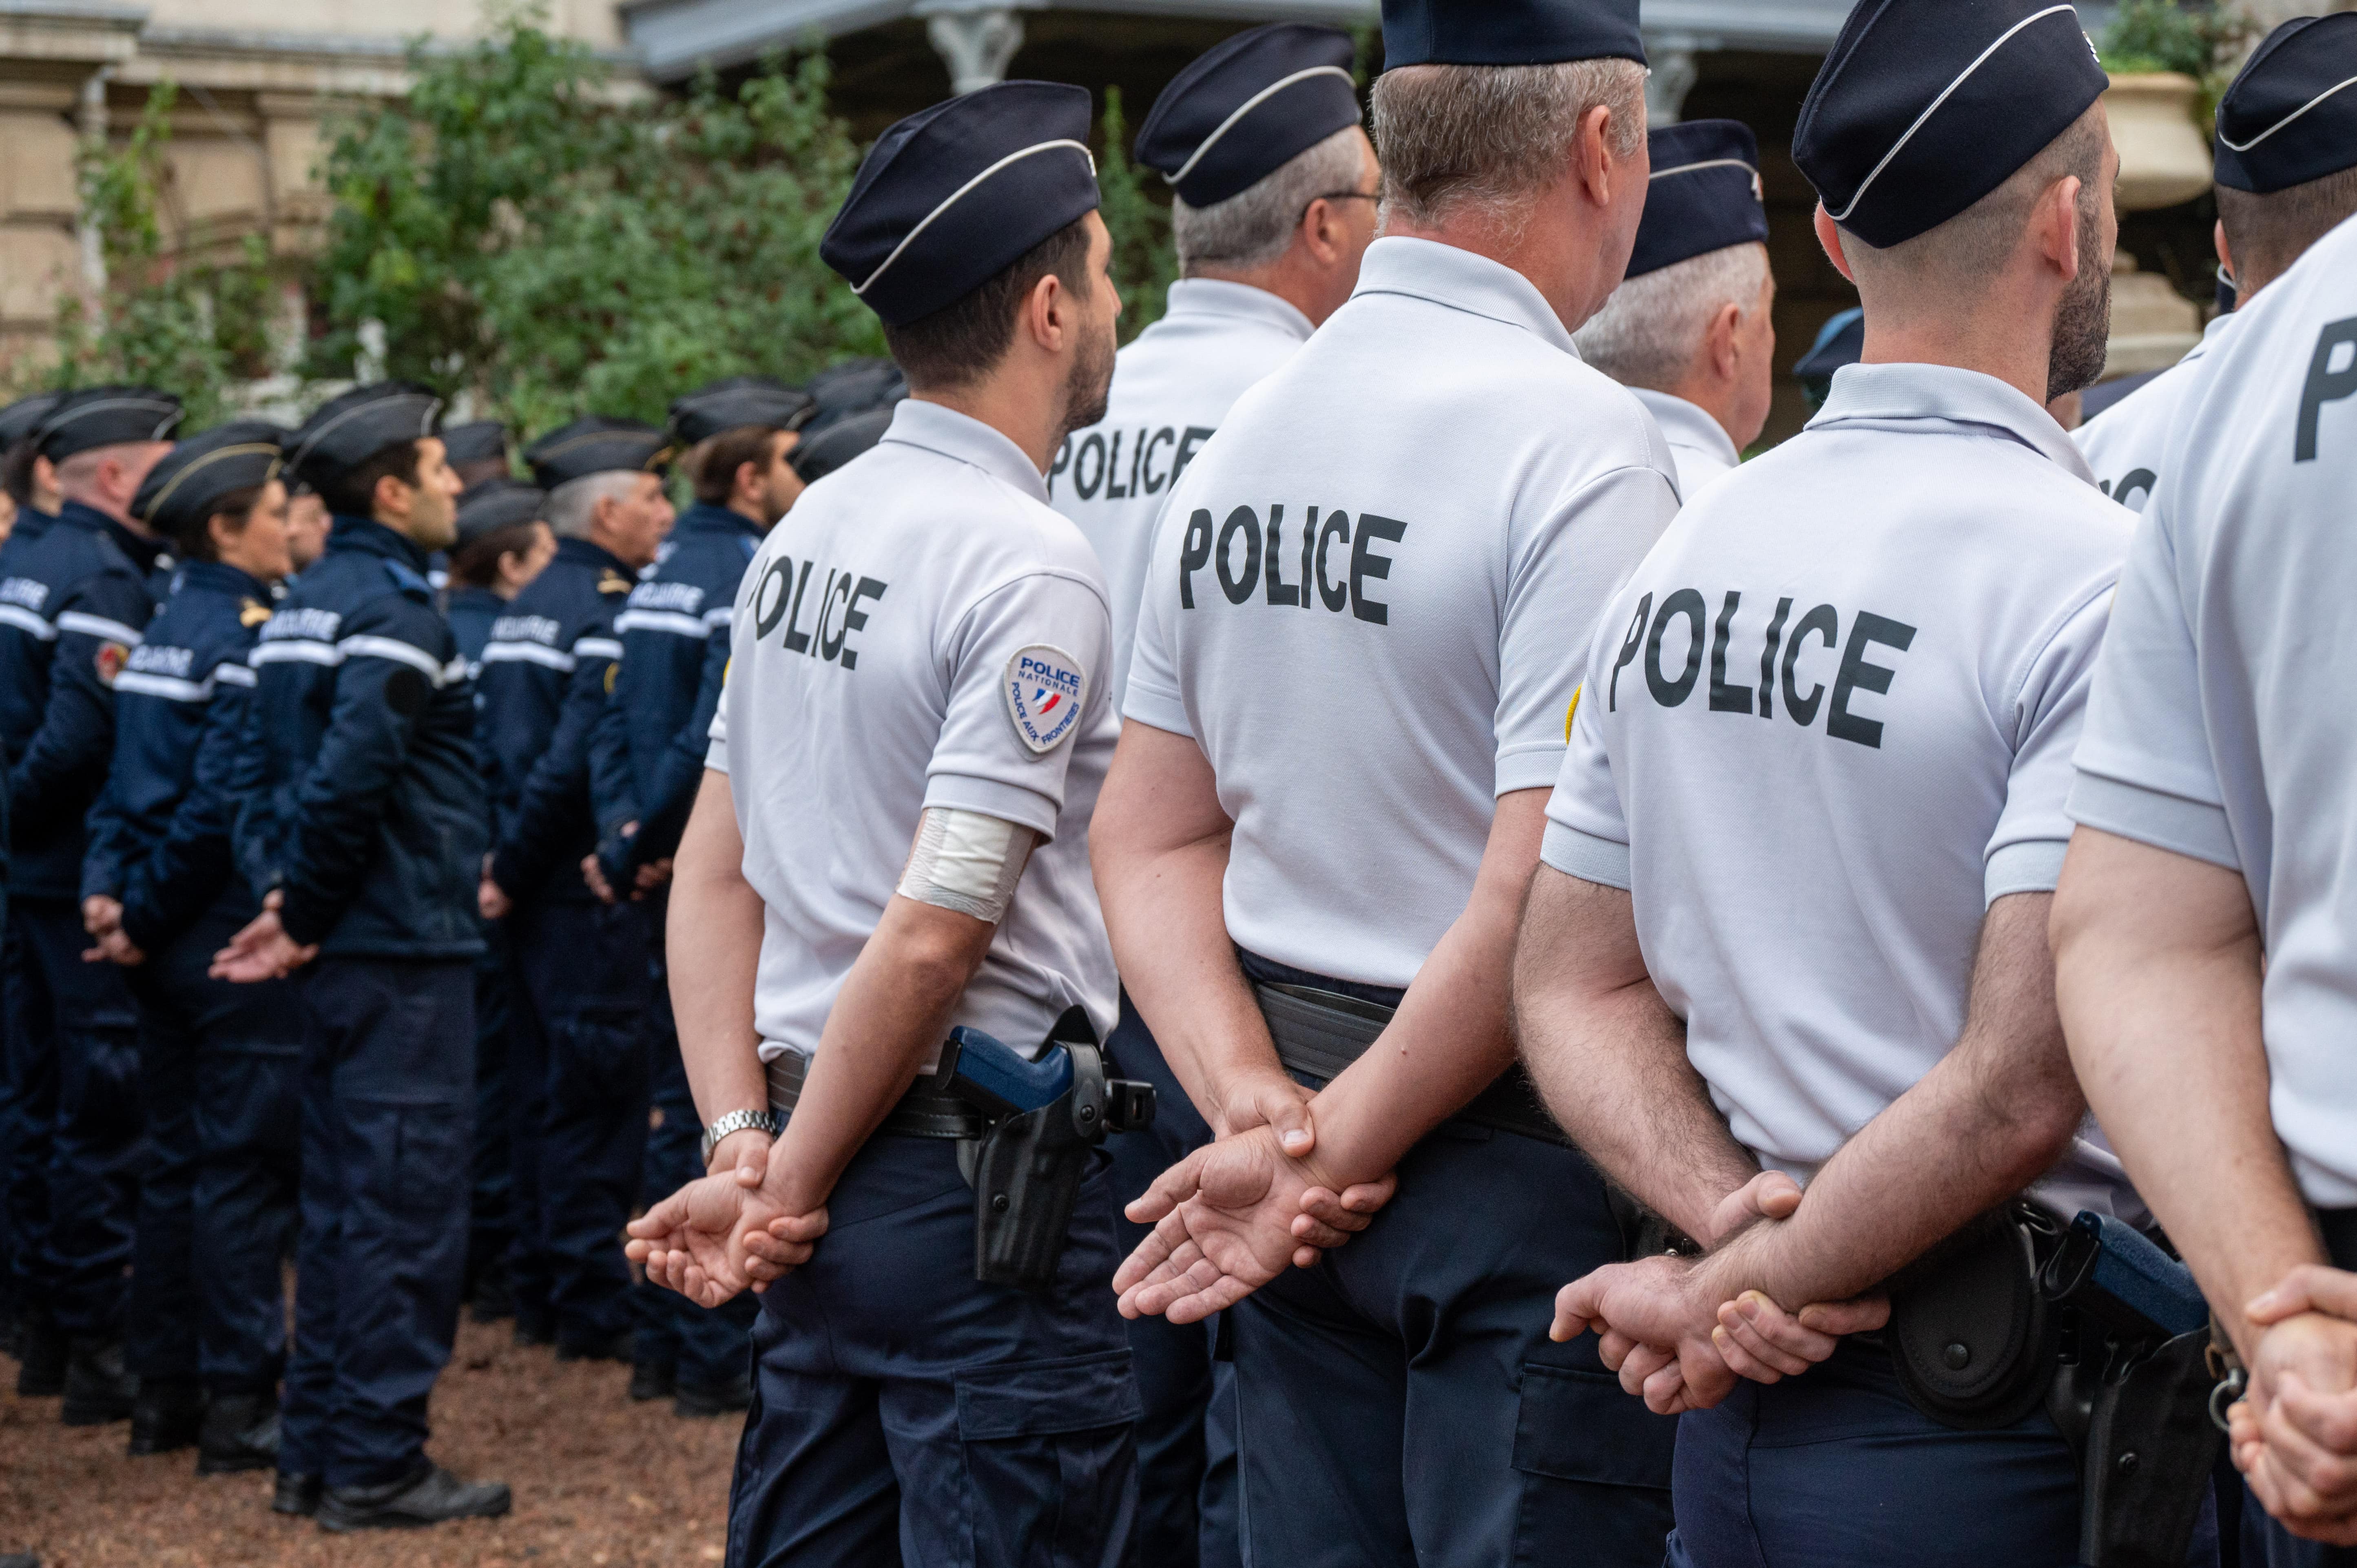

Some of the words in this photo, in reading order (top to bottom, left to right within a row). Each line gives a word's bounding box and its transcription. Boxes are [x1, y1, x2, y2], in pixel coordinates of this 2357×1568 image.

[1180, 504, 1408, 626] POLICE
[746, 555, 888, 671] OLICE
[1011, 681, 1027, 719] POLICE
[1023, 720, 1040, 742] AUX
[1041, 701, 1080, 745] FRONTIERES
[1018, 670, 1078, 697] NATIONALE
[1020, 657, 1080, 688] POLICE
[1609, 588, 1918, 749] POLICE
